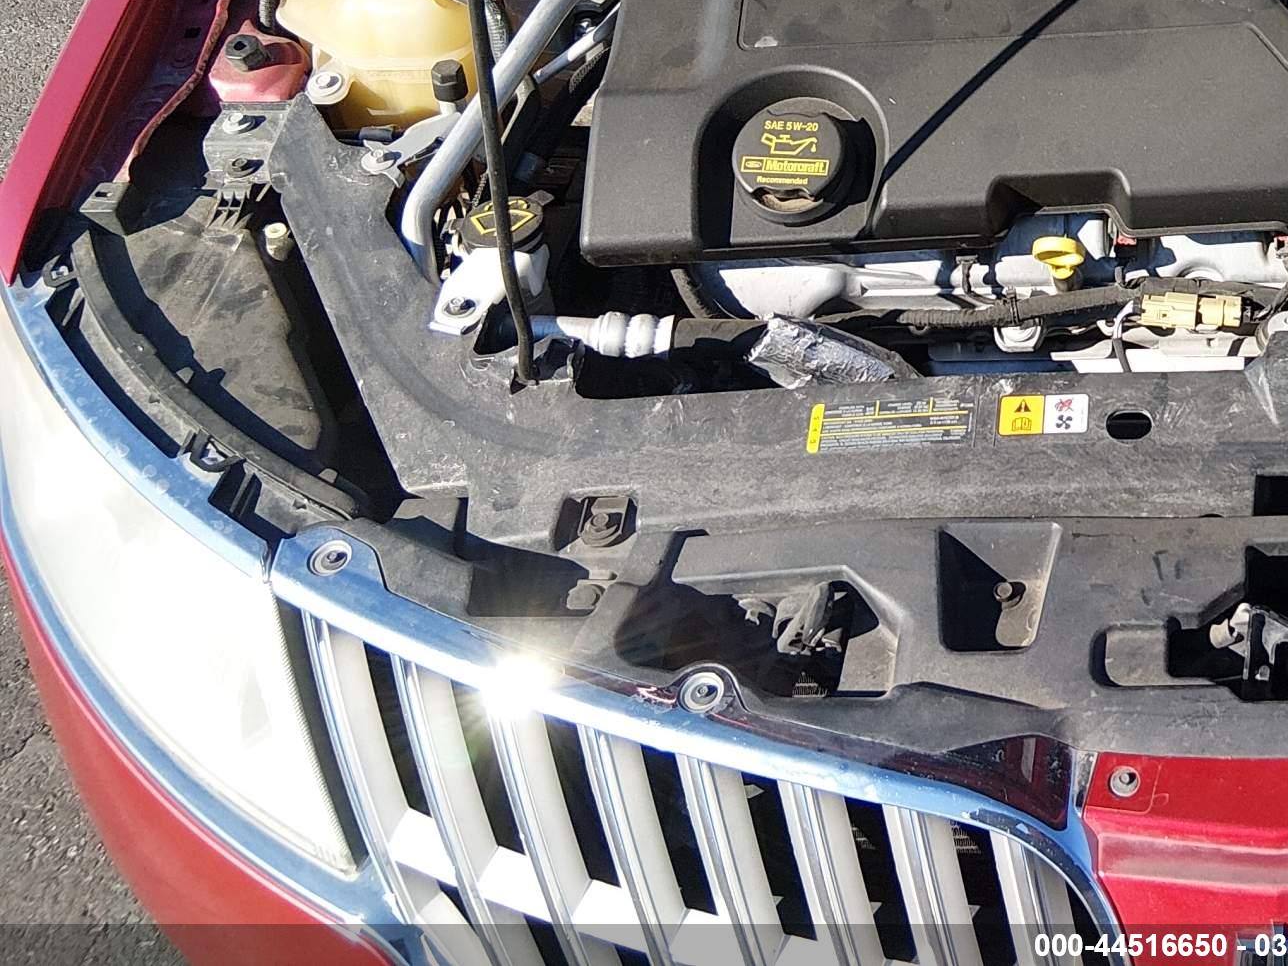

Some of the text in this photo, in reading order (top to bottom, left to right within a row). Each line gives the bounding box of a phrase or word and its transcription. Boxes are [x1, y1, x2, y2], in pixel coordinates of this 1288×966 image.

[763, 120, 819, 132] SAE 5W-20
[765, 159, 825, 173] Motorcraft
